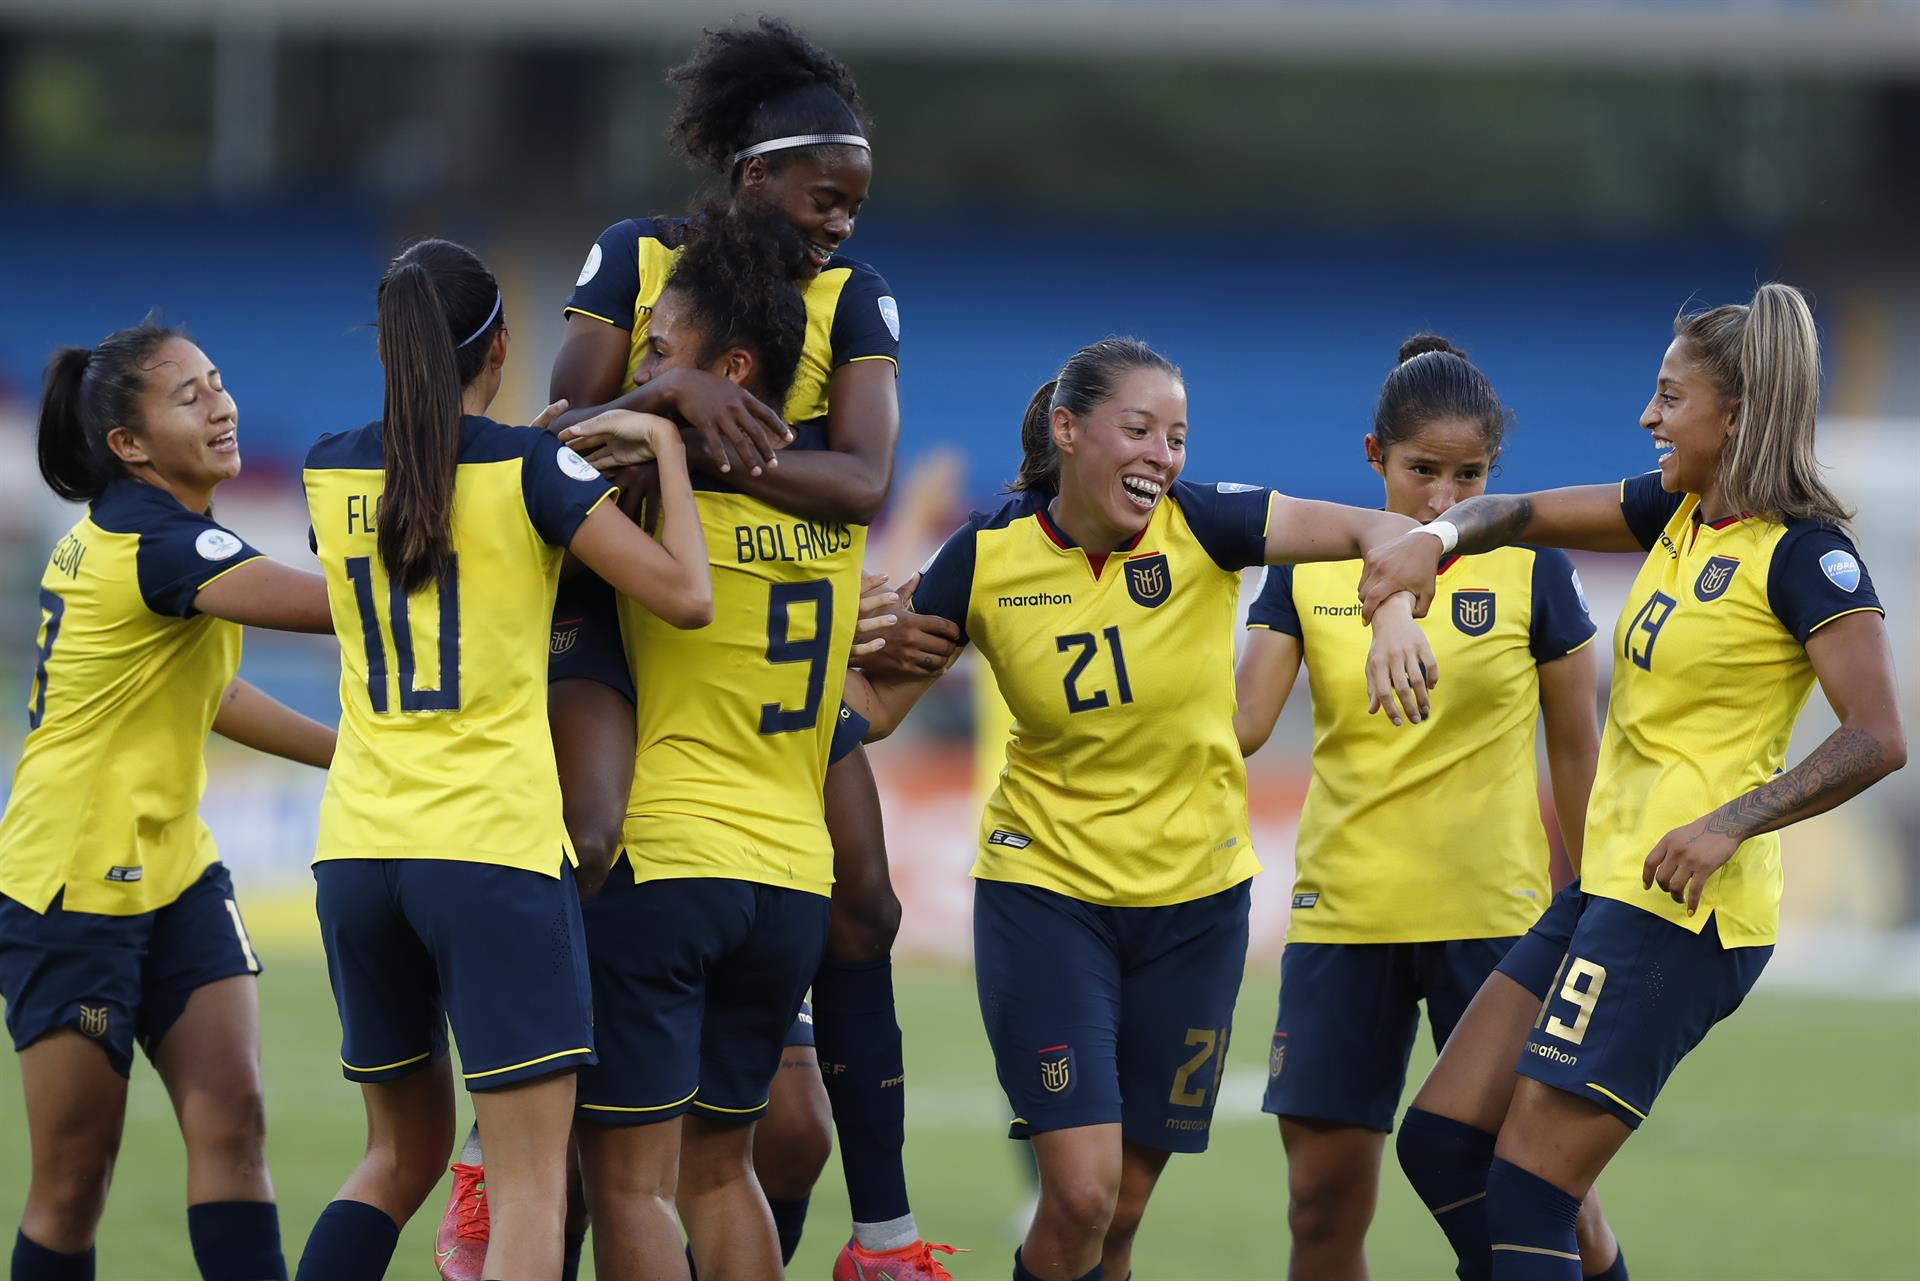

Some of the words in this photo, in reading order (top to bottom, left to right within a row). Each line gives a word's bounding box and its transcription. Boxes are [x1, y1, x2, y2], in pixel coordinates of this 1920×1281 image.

[344, 551, 462, 714] 10
[998, 593, 1072, 607] marathon
[1313, 604, 1363, 616] marath
[1624, 588, 1677, 672] 19
[759, 577, 834, 735] 9
[1055, 625, 1134, 714] 21
[1534, 953, 1607, 1046] 19
[1168, 1027, 1227, 1108] 21
